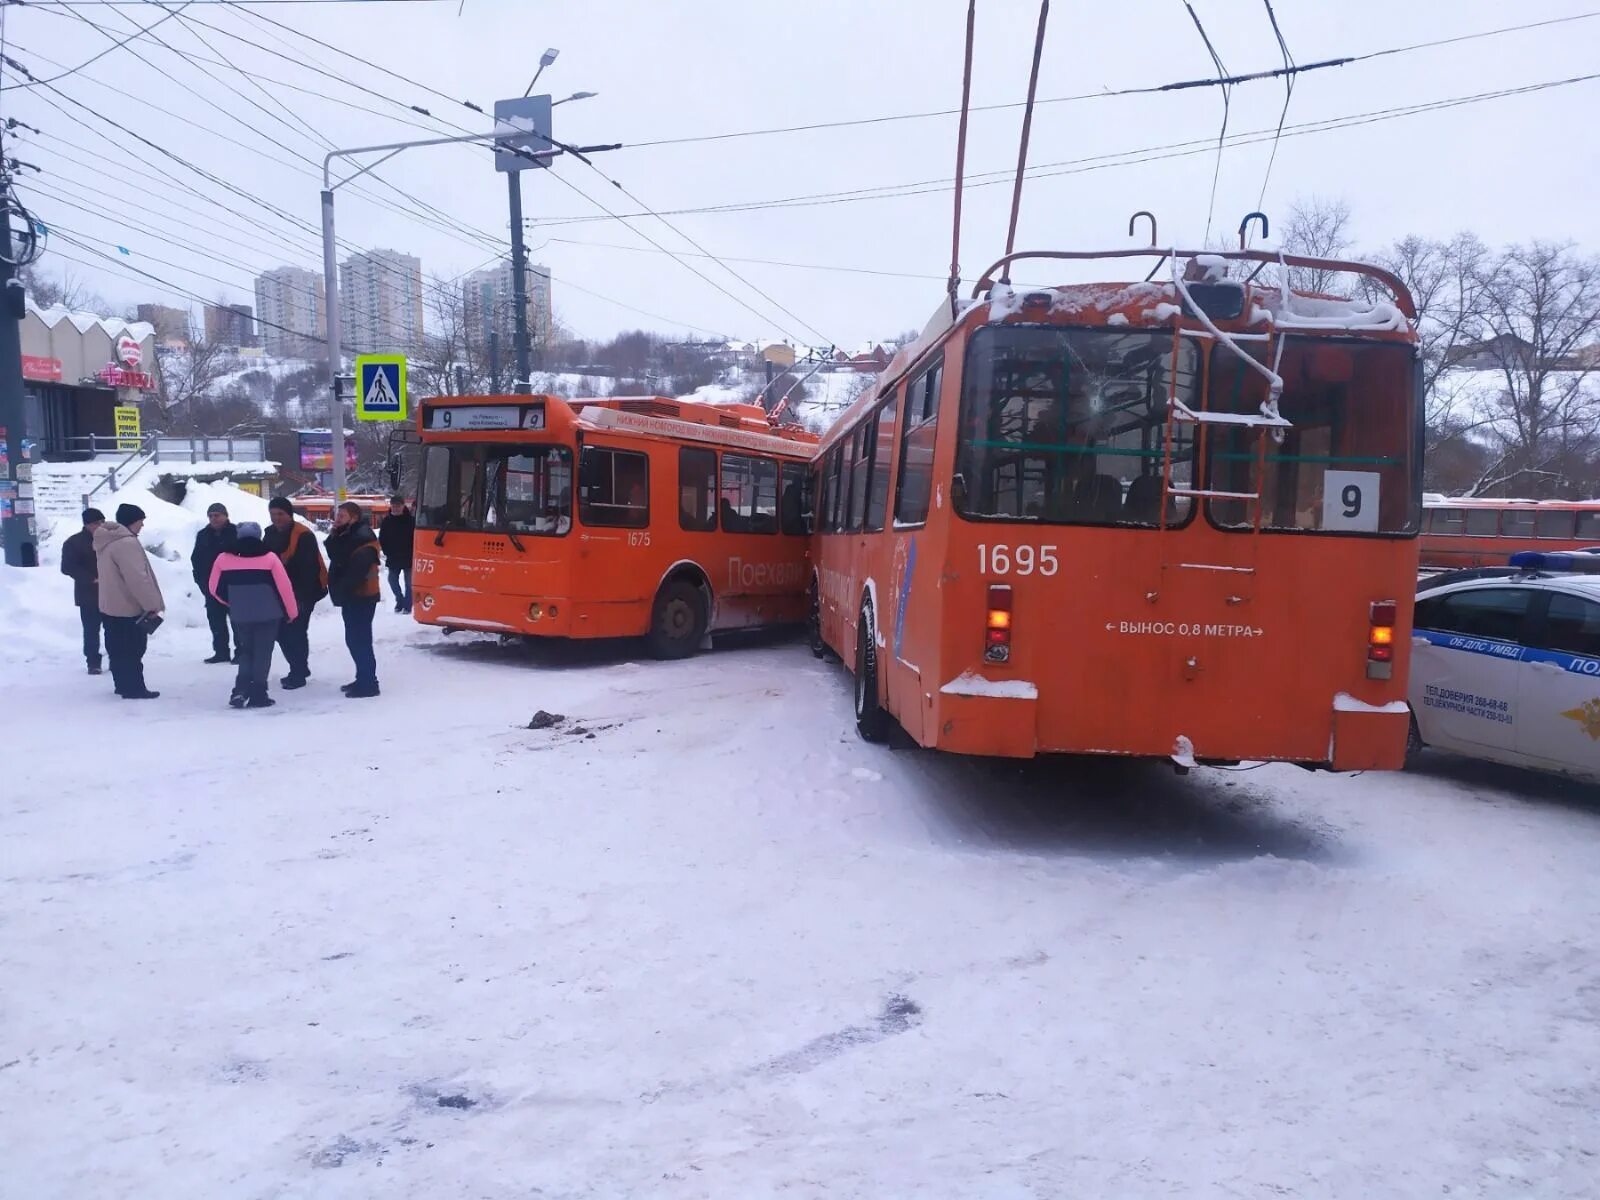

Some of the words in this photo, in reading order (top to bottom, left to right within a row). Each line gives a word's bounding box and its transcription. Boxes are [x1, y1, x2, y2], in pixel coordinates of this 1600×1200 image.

[443, 411, 452, 428] 9
[530, 414, 539, 427] 9
[1341, 484, 1362, 518] 9
[628, 531, 651, 547] 1675
[415, 558, 435, 575] 1675
[977, 543, 1060, 577] 1695
[1119, 621, 1176, 635] ВЫНОС
[1179, 623, 1201, 637] 0,8
[1204, 624, 1253, 638] МЕТРА
[1449, 637, 1464, 647] ОБ
[1463, 640, 1487, 651] ДПС
[1488, 644, 1520, 658] УМВД
